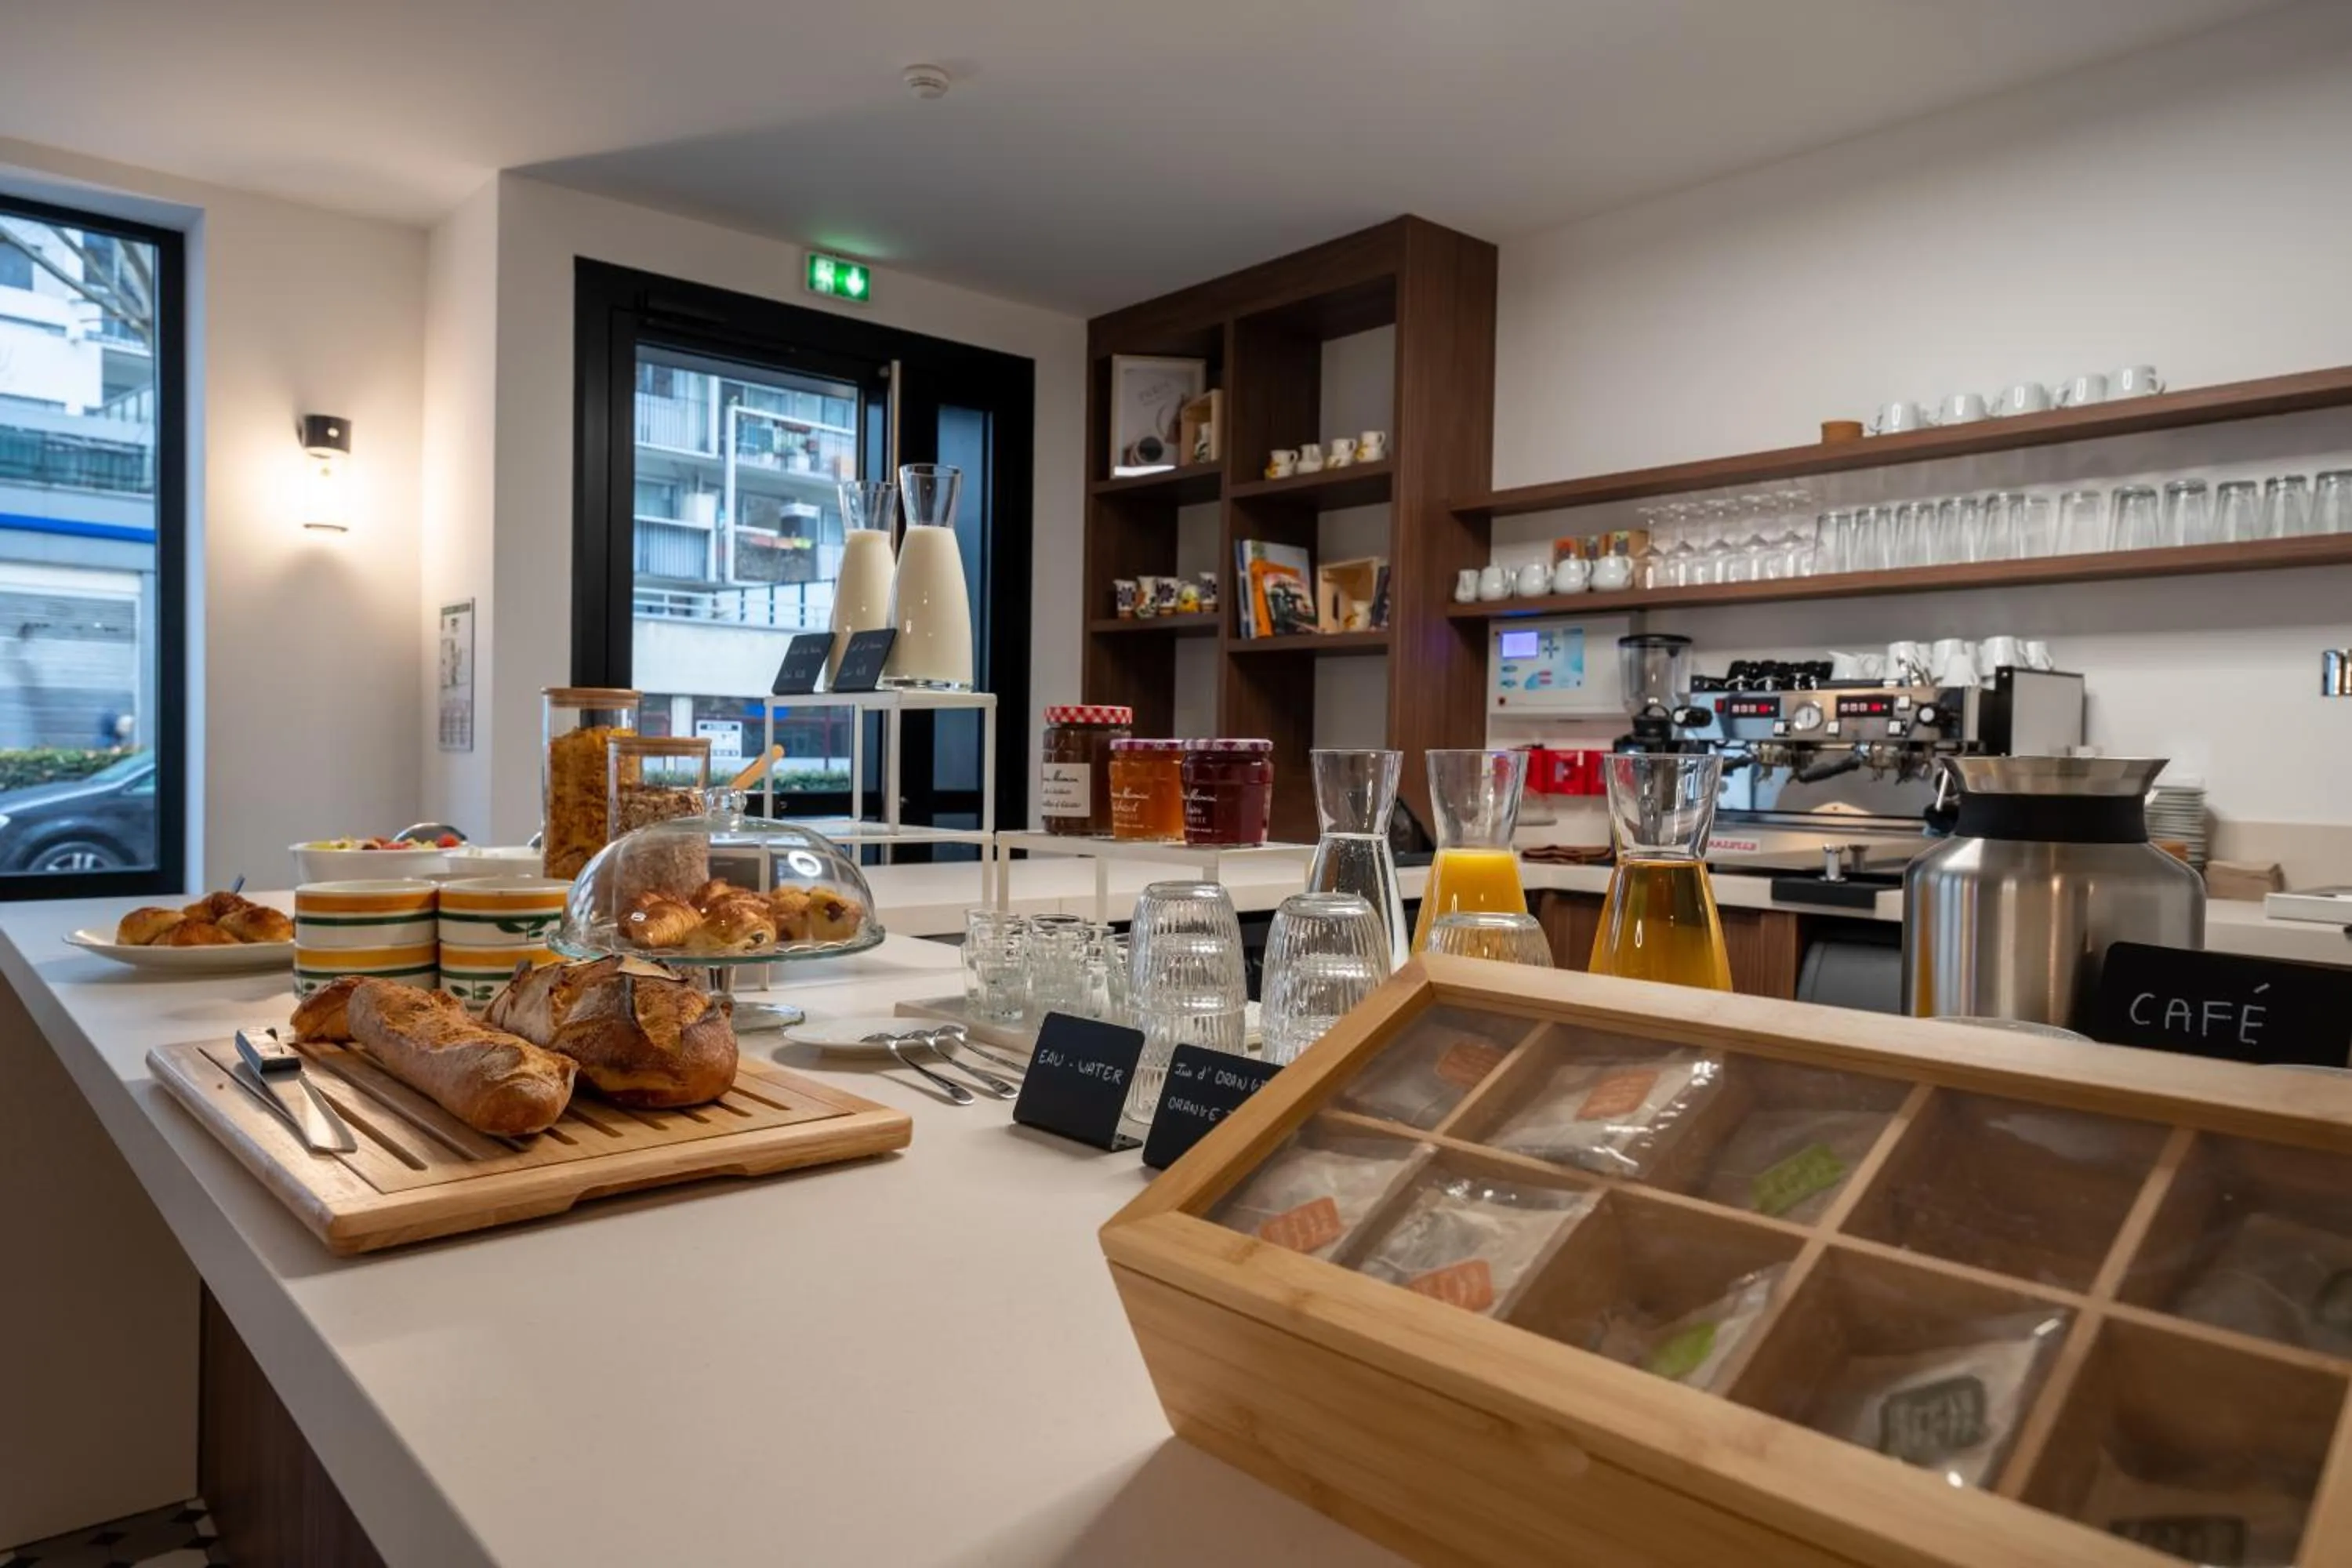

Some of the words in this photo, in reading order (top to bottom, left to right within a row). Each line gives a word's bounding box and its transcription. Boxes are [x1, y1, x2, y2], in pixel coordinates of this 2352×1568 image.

[2129, 982, 2270, 1045] CAFÉ
[1037, 1049, 1065, 1067] EAU
[1078, 1058, 1124, 1085] WATER
